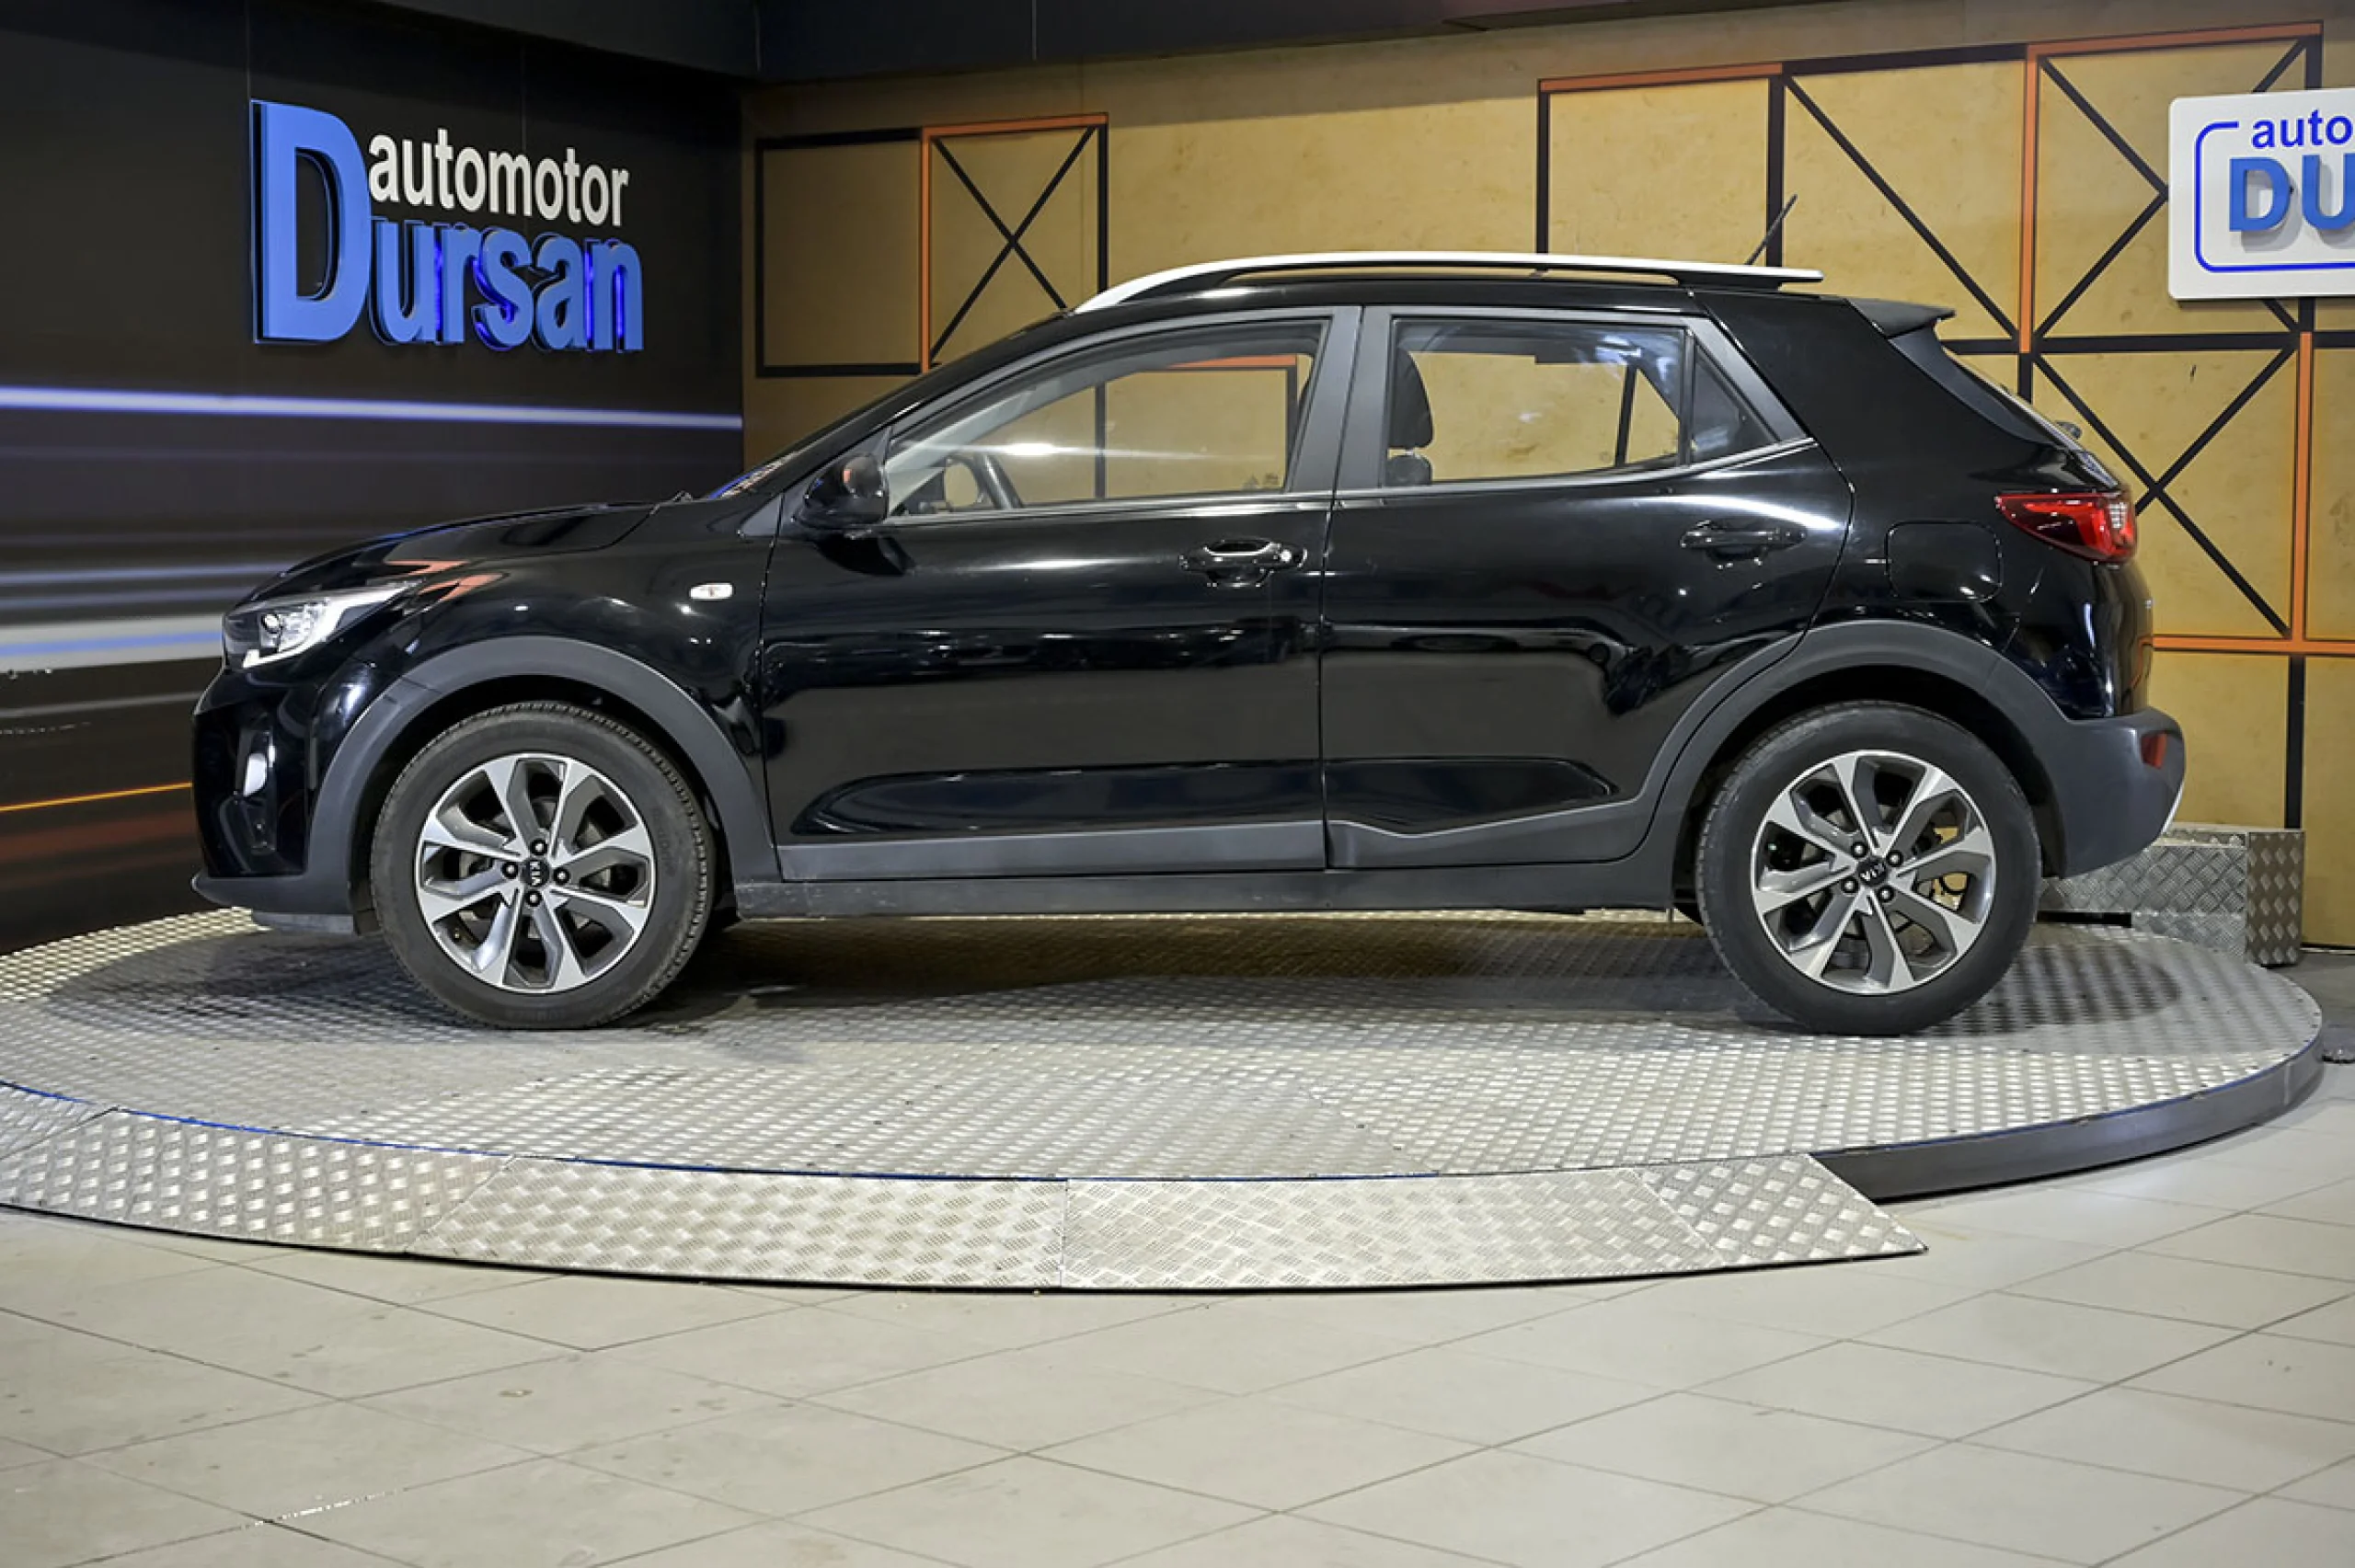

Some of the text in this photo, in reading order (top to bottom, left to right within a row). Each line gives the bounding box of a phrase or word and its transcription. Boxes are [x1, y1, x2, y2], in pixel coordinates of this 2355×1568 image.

[2252, 109, 2354, 149] auto
[369, 129, 628, 226] automotor
[2229, 152, 2355, 233] DU
[250, 98, 644, 353] Dursan
[530, 861, 541, 887] KIA
